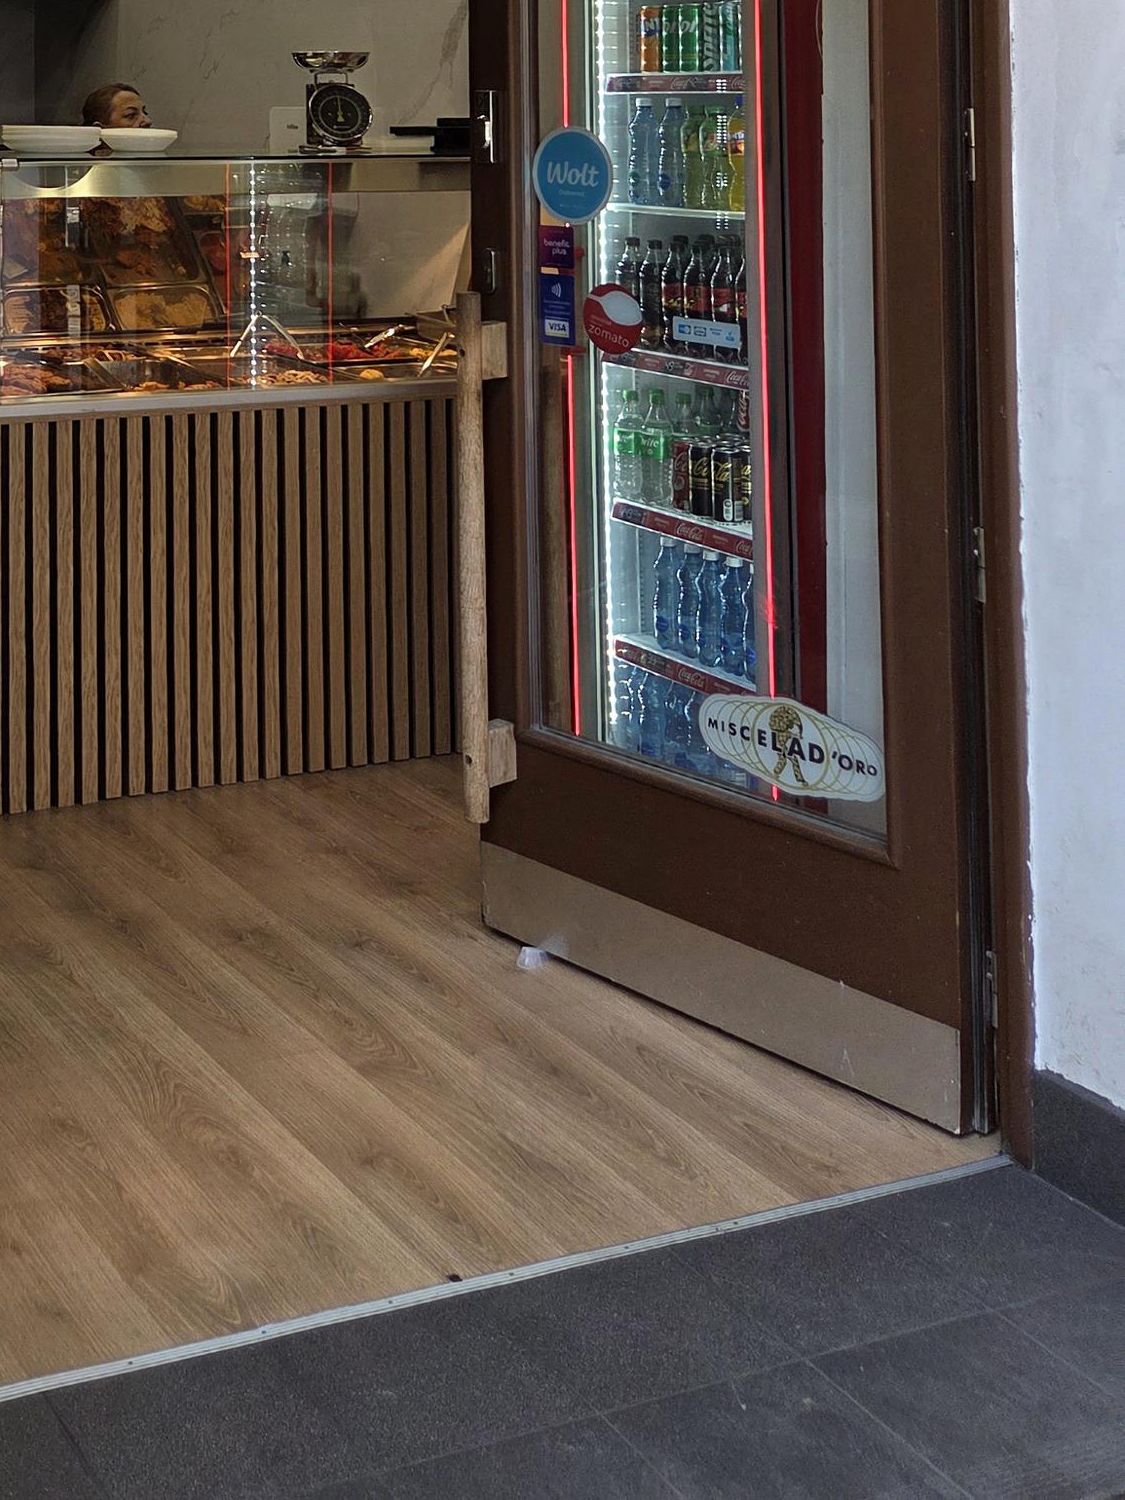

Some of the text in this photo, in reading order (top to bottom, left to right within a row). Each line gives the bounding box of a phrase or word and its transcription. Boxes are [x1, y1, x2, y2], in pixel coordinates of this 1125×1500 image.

[546, 160, 600, 188] Wolt
[543, 239, 571, 248] benefit
[551, 246, 567, 256] plus
[548, 322, 567, 332] VISA
[588, 323, 630, 348] zomato
